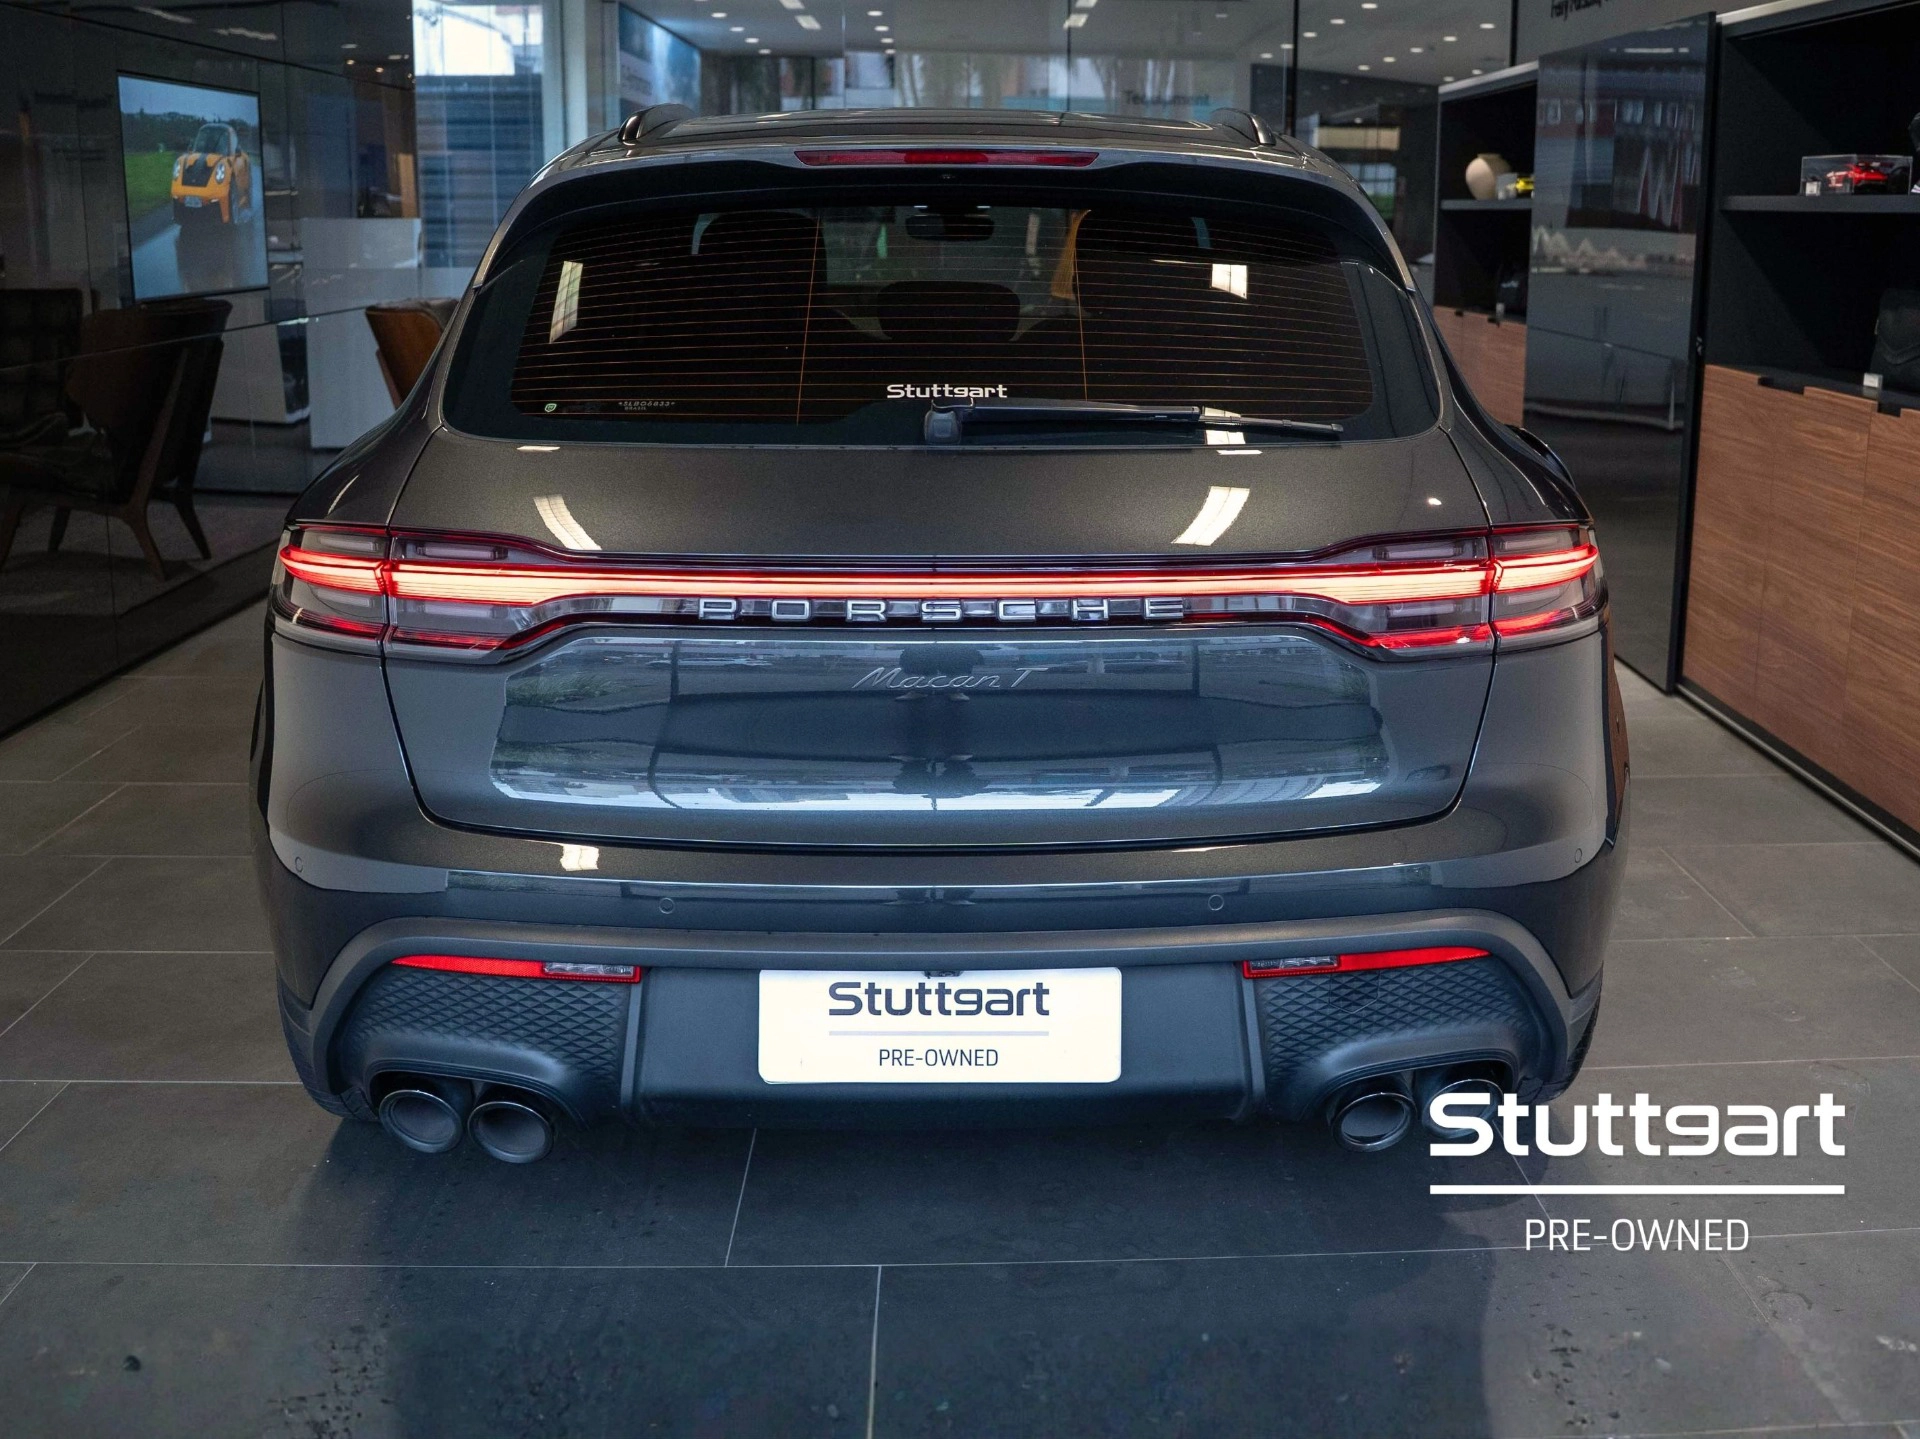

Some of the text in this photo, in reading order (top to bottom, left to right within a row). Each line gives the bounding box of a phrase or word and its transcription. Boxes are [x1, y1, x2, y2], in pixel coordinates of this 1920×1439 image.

[886, 384, 1007, 398] Stuttgart
[699, 597, 1184, 620] PORSCHE
[852, 667, 1049, 688] Macan T
[828, 981, 1050, 1016] Stuttgart
[879, 1049, 999, 1067] PRE-OWNED
